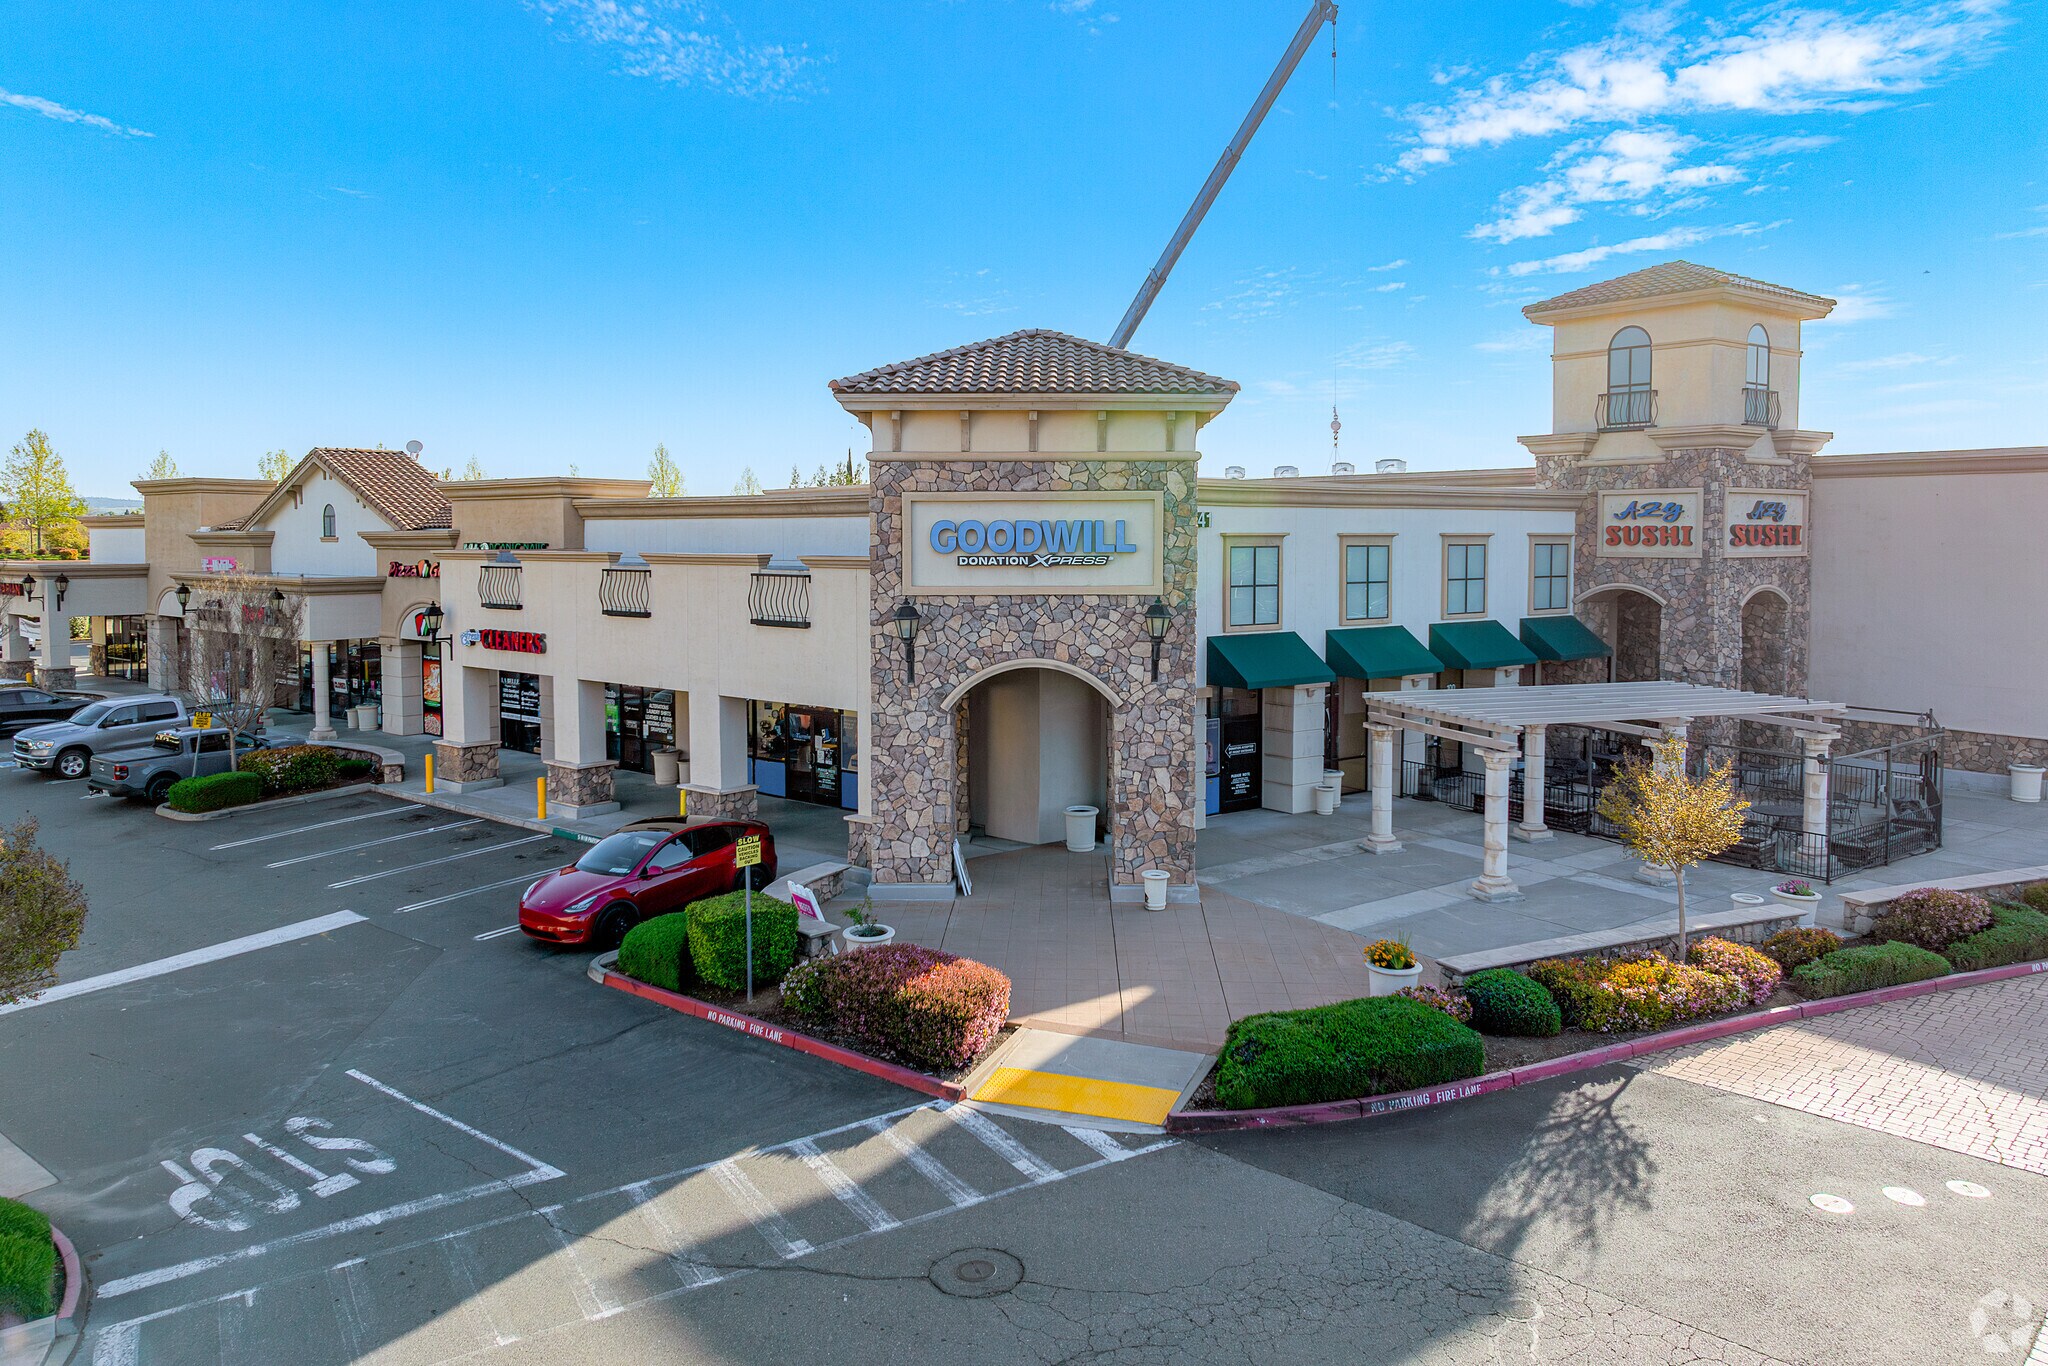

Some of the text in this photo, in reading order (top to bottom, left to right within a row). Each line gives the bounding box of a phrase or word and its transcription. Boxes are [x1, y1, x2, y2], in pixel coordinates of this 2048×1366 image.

[929, 519, 1137, 554] GOODWILL
[1604, 525, 1694, 546] SUSHI
[1731, 524, 1802, 546] SUSHI
[388, 561, 417, 577] Pizza
[958, 554, 1109, 567] DONATION XPRESS
[481, 629, 545, 654] CLEANERS
[737, 834, 760, 846] SLOW
[737, 844, 760, 853] CAUTION
[738, 849, 759, 857] VEHICLES
[707, 1010, 783, 1043] NO PARKING FIRE LANE
[1371, 1084, 1481, 1113] NO PARKING FIRE LANE
[160, 1116, 398, 1232] STOP
